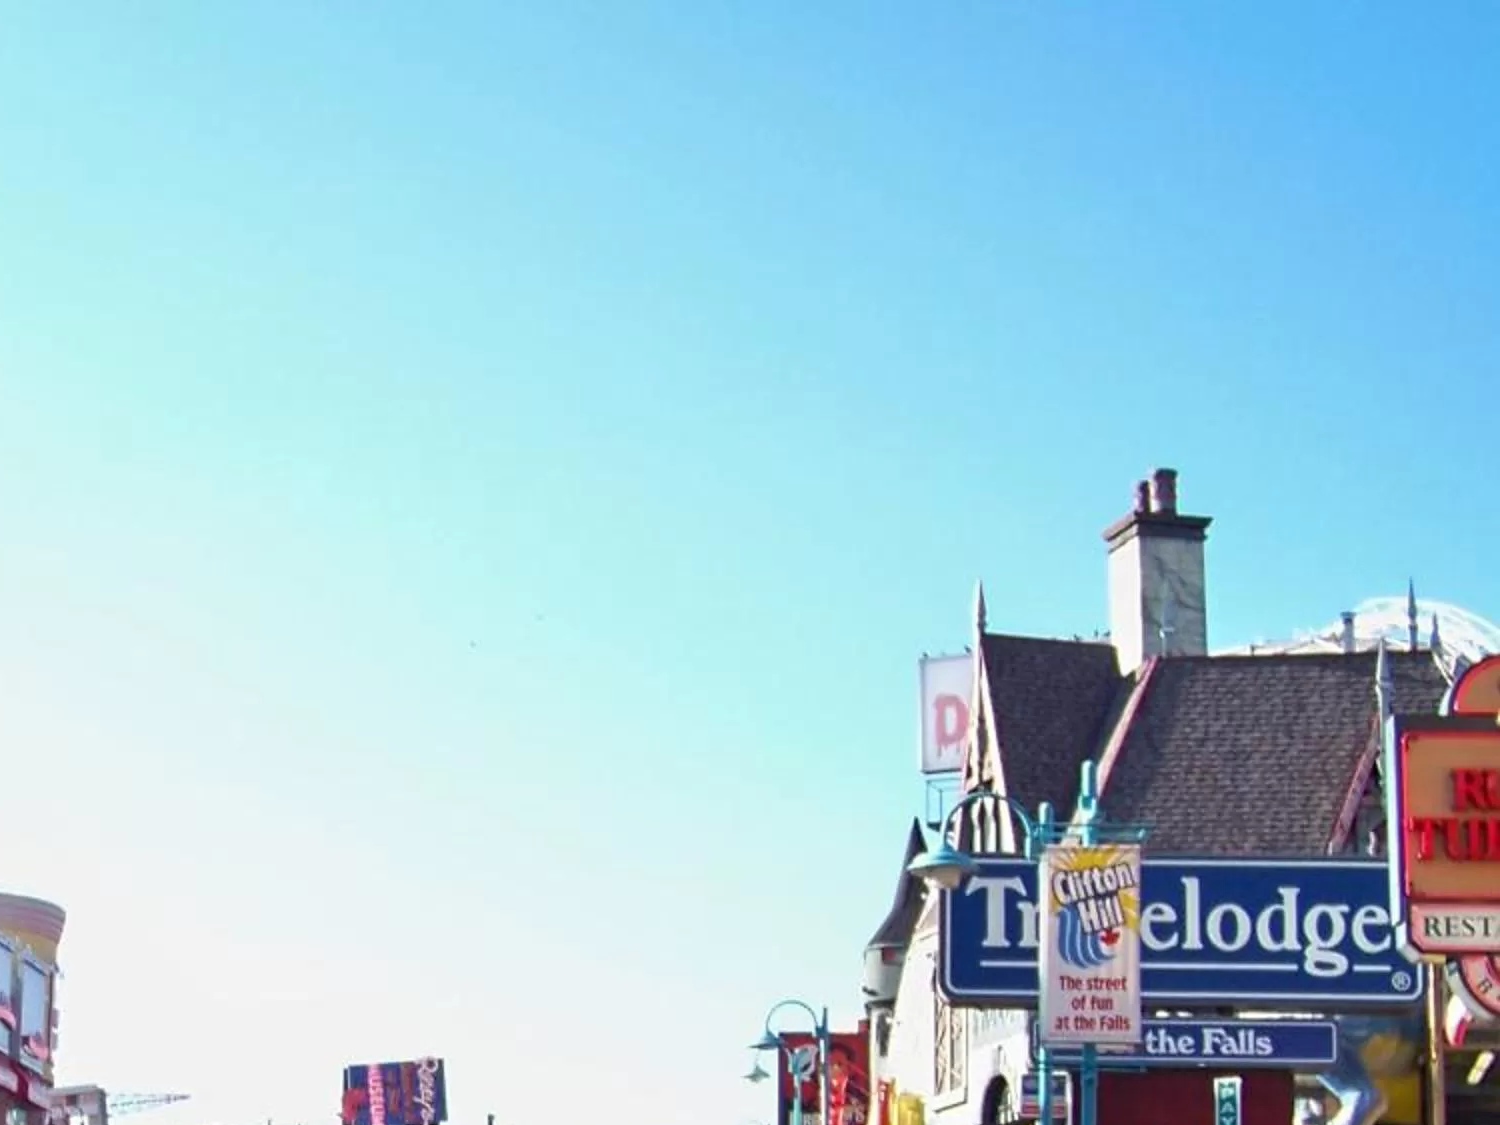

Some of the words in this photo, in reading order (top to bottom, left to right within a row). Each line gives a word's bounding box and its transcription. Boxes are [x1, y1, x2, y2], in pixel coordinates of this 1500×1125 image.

[1053, 862, 1137, 906] Clifton
[964, 876, 1393, 978] Trelodge
[1076, 894, 1126, 935] Hill
[1059, 975, 1083, 992] The
[1086, 976, 1128, 992] street
[1071, 997, 1087, 1012] of
[1091, 997, 1114, 1012] fun
[1055, 1017, 1070, 1032] at
[1074, 1015, 1097, 1032] the
[1100, 1016, 1131, 1032] Falls
[1145, 1030, 1195, 1056] the
[1202, 1028, 1273, 1056] Falls
